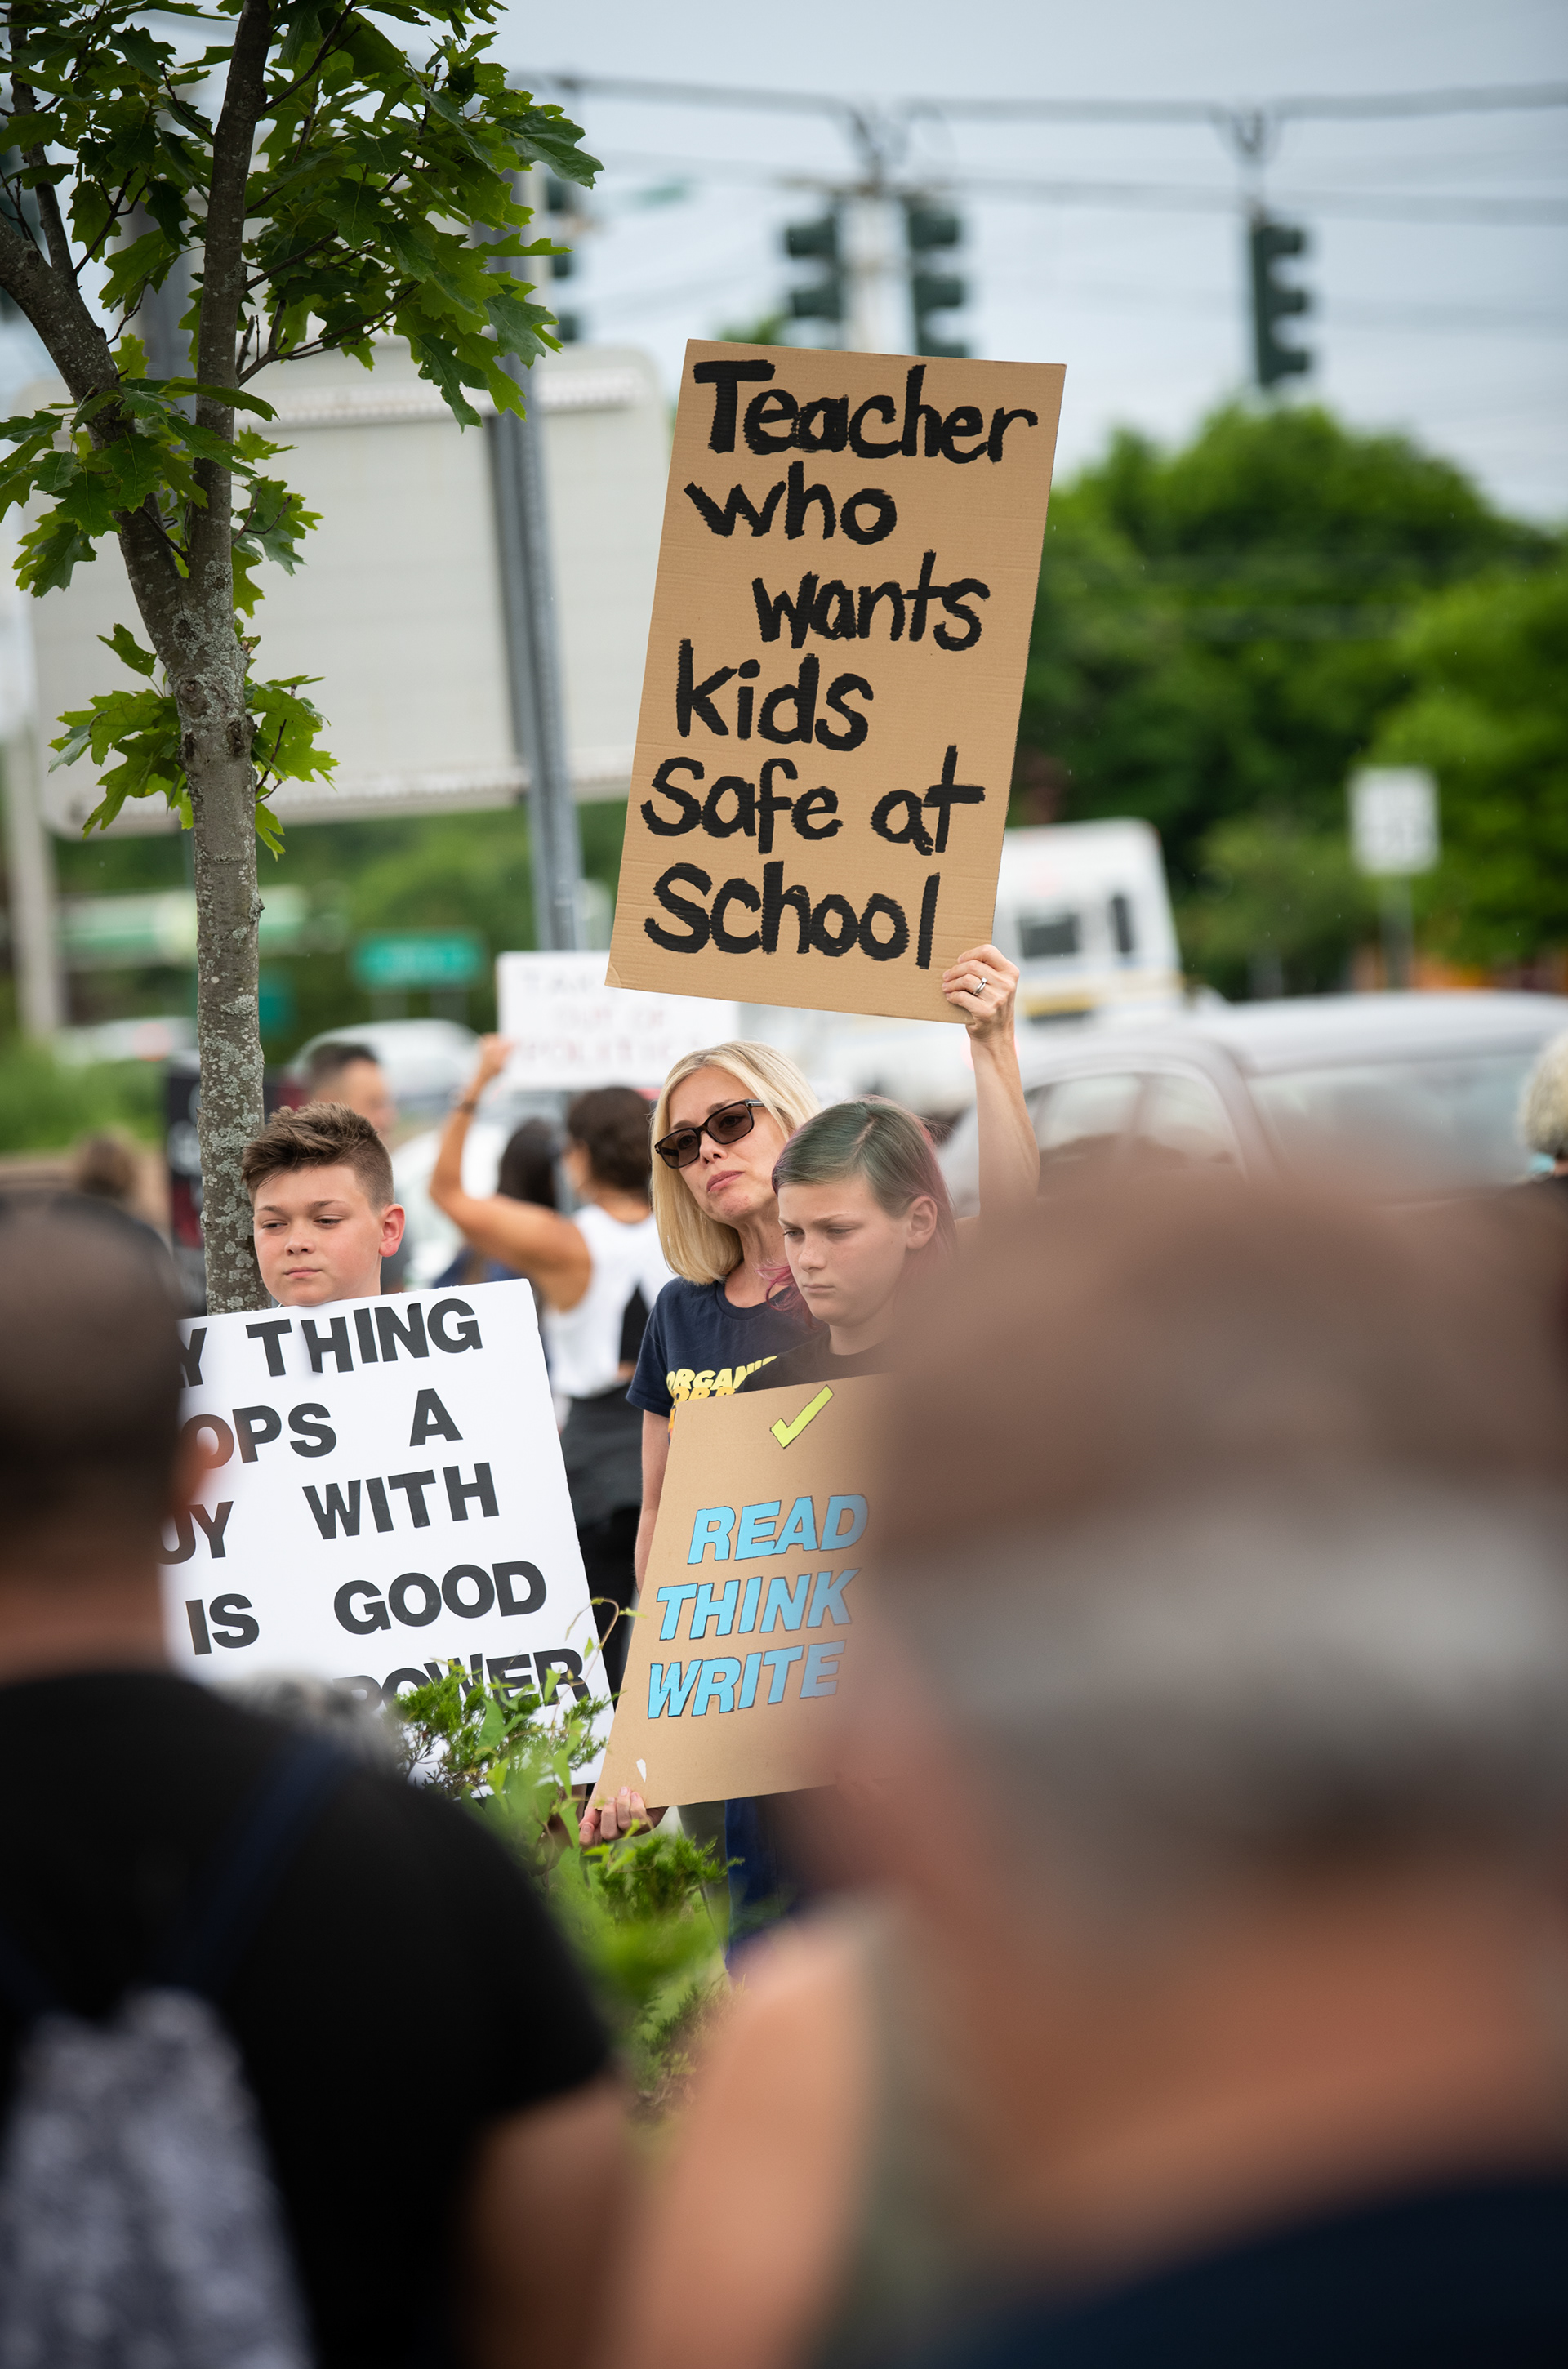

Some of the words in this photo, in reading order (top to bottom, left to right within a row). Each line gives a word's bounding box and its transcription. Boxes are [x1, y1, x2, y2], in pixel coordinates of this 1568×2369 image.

[693, 359, 1038, 464] Teacher
[684, 461, 897, 545] who
[752, 550, 990, 651] wants
[871, 745, 985, 855] at
[644, 861, 940, 969] School
[246, 1298, 483, 1378] THING
[181, 1403, 337, 1469] OPS
[410, 1388, 463, 1446] A
[157, 1501, 234, 1565] UY
[302, 1463, 499, 1539] WITH
[687, 1494, 868, 1565] READ
[185, 1593, 259, 1656] IS
[334, 1561, 546, 1635] GOOD
[657, 1568, 862, 1641] THINK
[648, 1639, 847, 1719] WRITE
